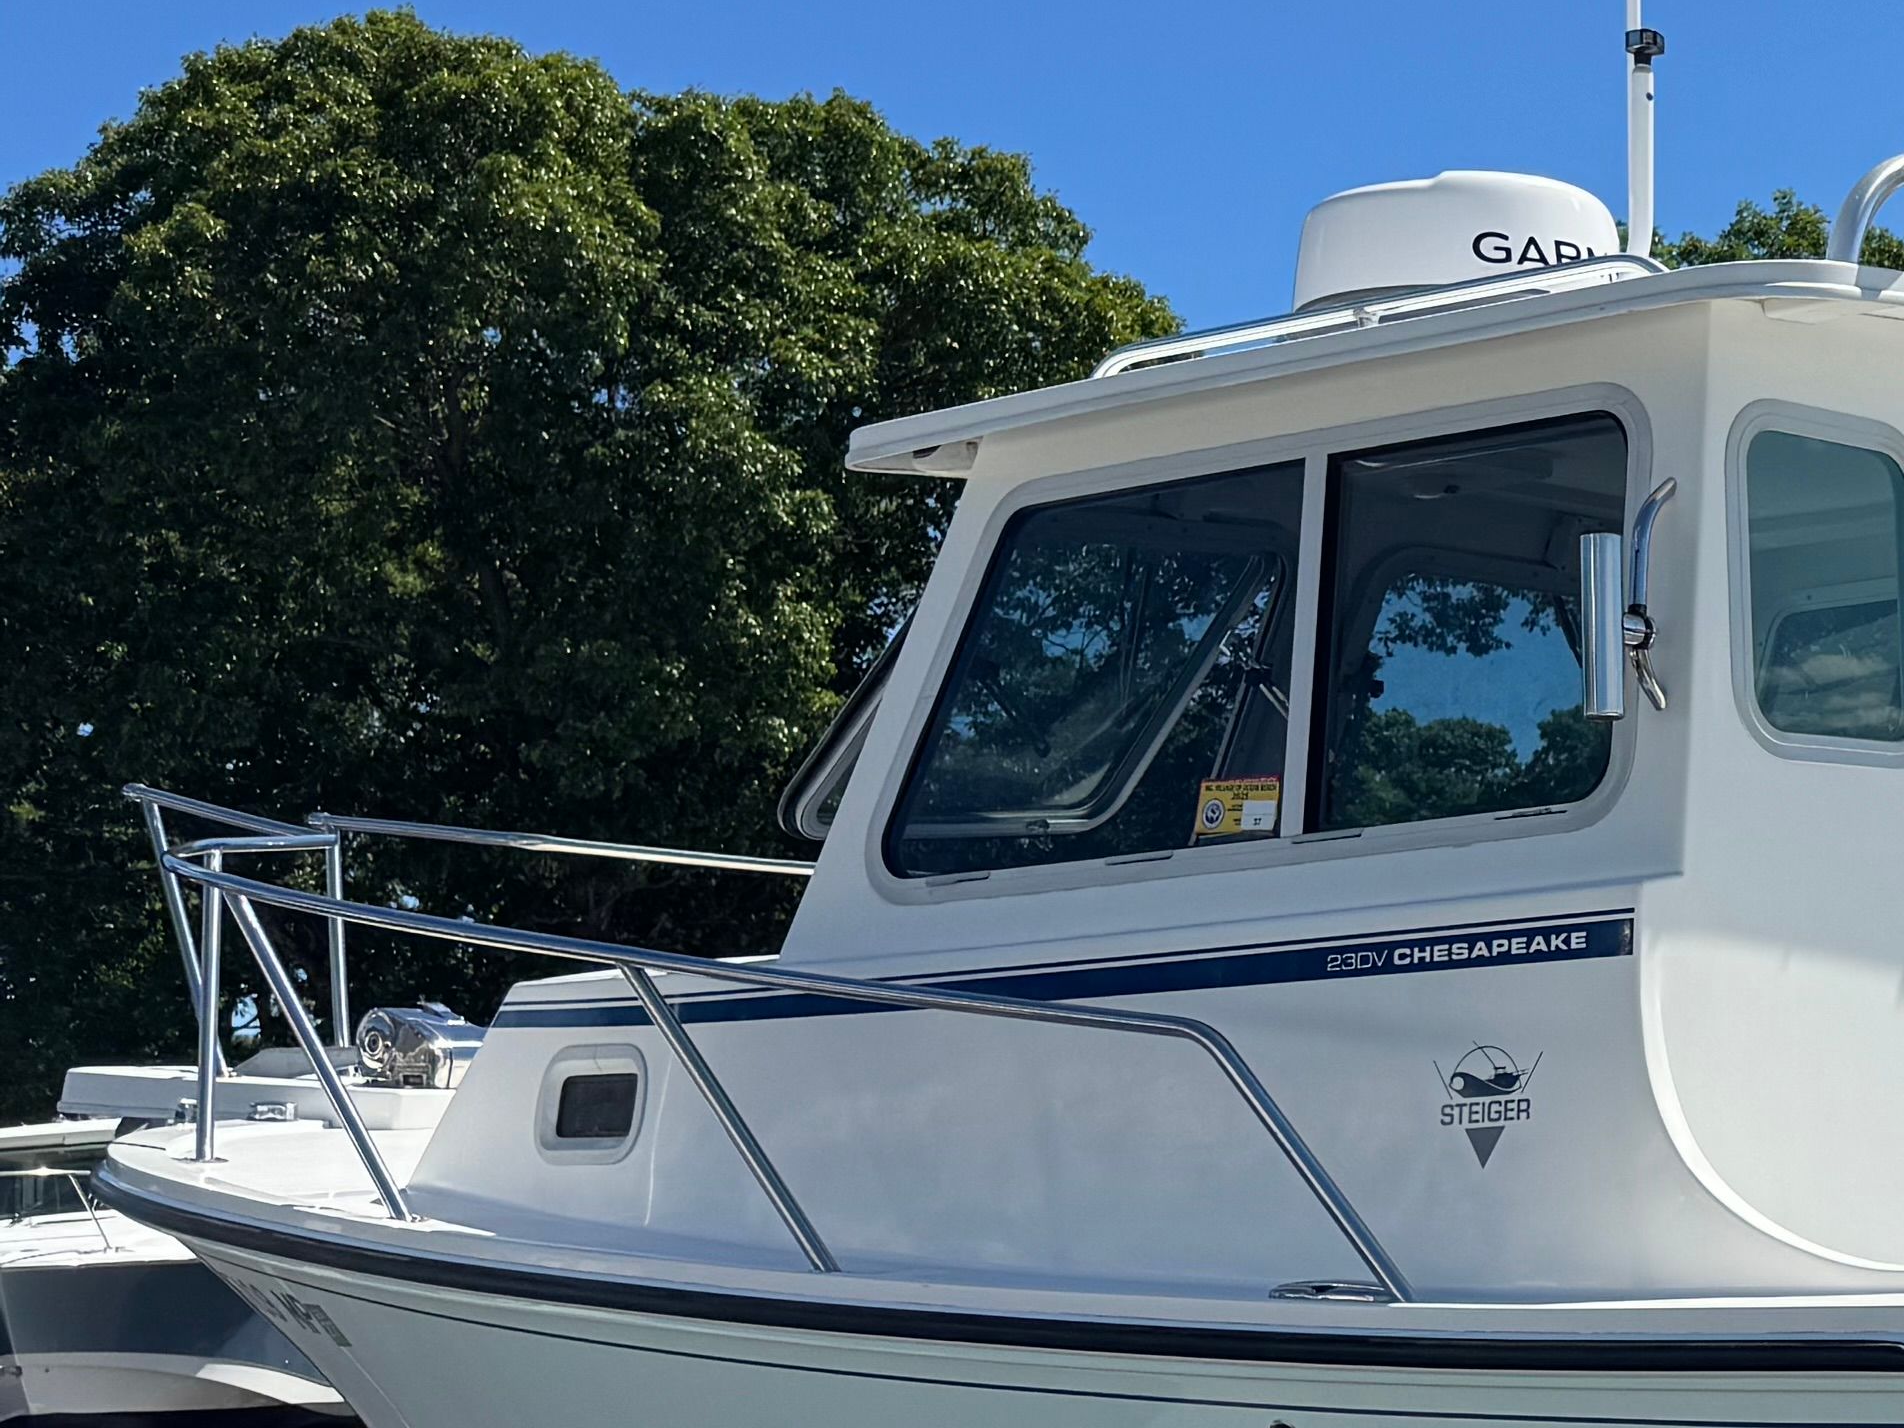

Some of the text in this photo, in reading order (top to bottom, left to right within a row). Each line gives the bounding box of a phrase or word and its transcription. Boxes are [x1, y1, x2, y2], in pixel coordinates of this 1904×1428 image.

[1472, 231, 1607, 265] GAR
[1393, 931, 1588, 965] CHESAPEAKE
[1440, 1097, 1532, 1126] STEIGER
